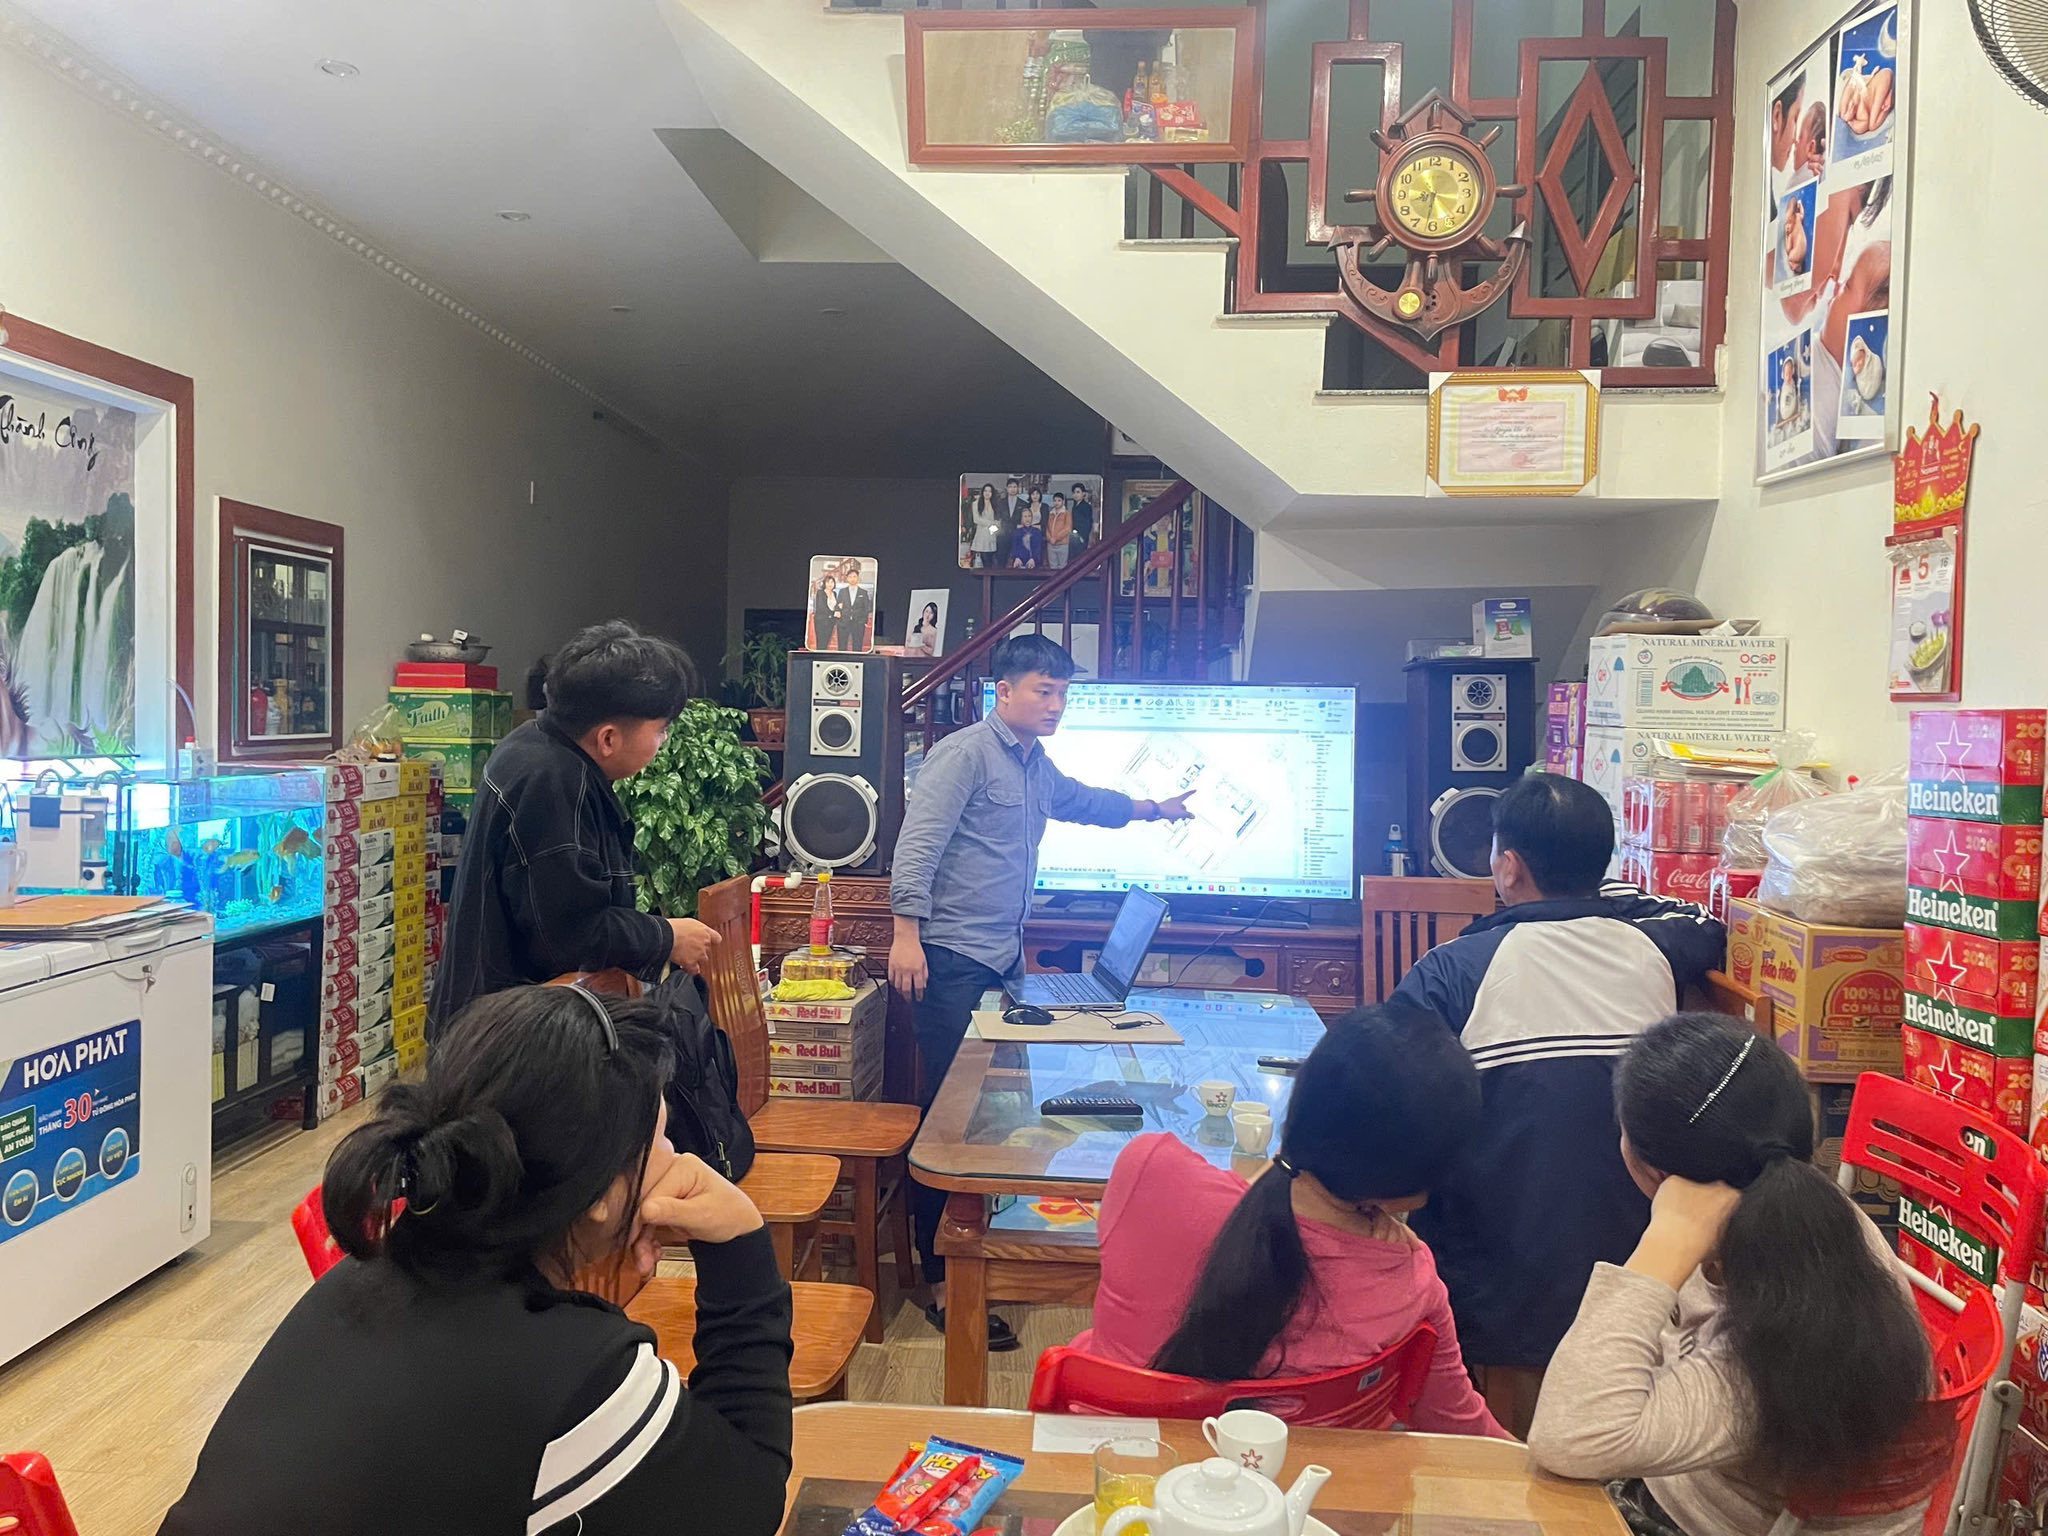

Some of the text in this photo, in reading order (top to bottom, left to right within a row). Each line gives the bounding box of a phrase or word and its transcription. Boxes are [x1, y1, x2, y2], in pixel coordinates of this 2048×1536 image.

[1412, 162, 1421, 171] 11
[1429, 157, 1441, 166] 12
[1449, 160, 1454, 170] 1
[1401, 174, 1412, 184] 10
[1459, 172, 1469, 182] 2
[1398, 191, 1406, 200] 9
[1462, 189, 1471, 198] 3
[1400, 206, 1410, 215] 8
[1456, 205, 1465, 214] 4
[1410, 218, 1420, 228] 7
[1428, 221, 1437, 231] 6
[1919, 553, 1929, 580] 5
[1642, 638, 1776, 649] NATURAL MINERAL WATER
[1638, 731, 1771, 743] NATURAL MINERAL WATER
[2016, 749, 2032, 765] 24
[1908, 782, 1999, 816] Heineken
[2015, 864, 2031, 880] 24
[1907, 888, 1997, 932] Heineken
[1843, 986, 1900, 1001] 100% LY
[2012, 981, 2027, 997] 24
[797, 1006, 817, 1019] Red
[1904, 992, 1994, 1047] Heineken
[796, 1044, 841, 1058] Red Bull
[795, 1081, 841, 1095] Red Bull
[64, 1092, 92, 1129] 30
[2007, 1099, 2022, 1115] 24
[38, 1119, 62, 1136] THÁNG
[1898, 1196, 1985, 1275] Heineken
